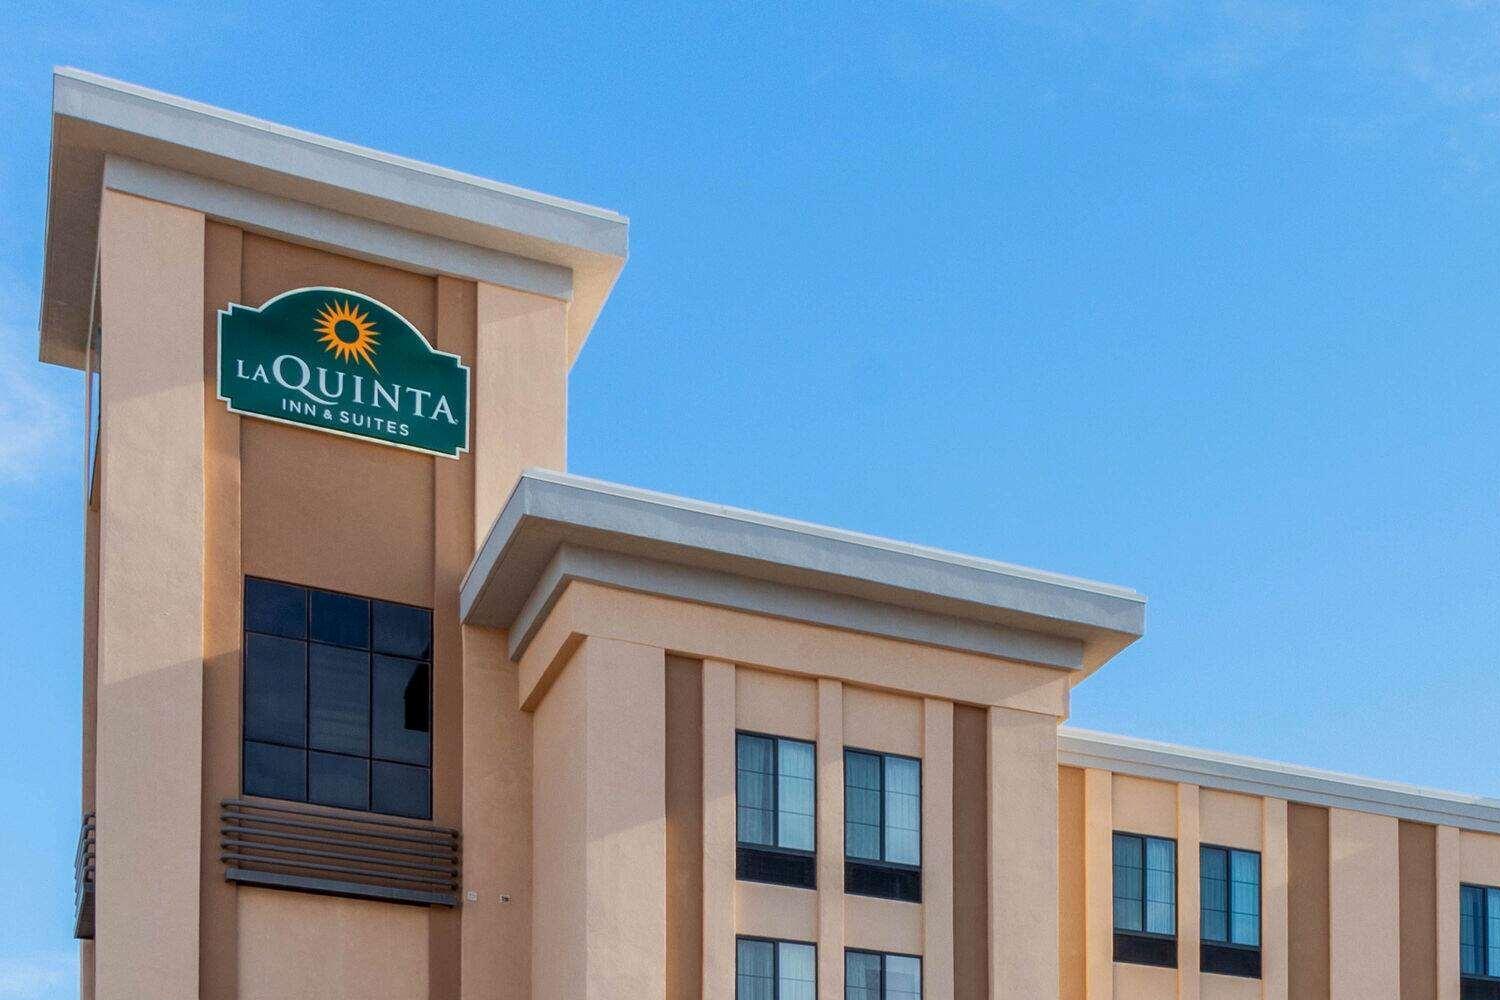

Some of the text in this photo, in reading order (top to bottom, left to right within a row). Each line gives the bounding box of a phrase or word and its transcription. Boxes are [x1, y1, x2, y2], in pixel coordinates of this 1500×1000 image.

[282, 398, 410, 437] INN & SUITES
